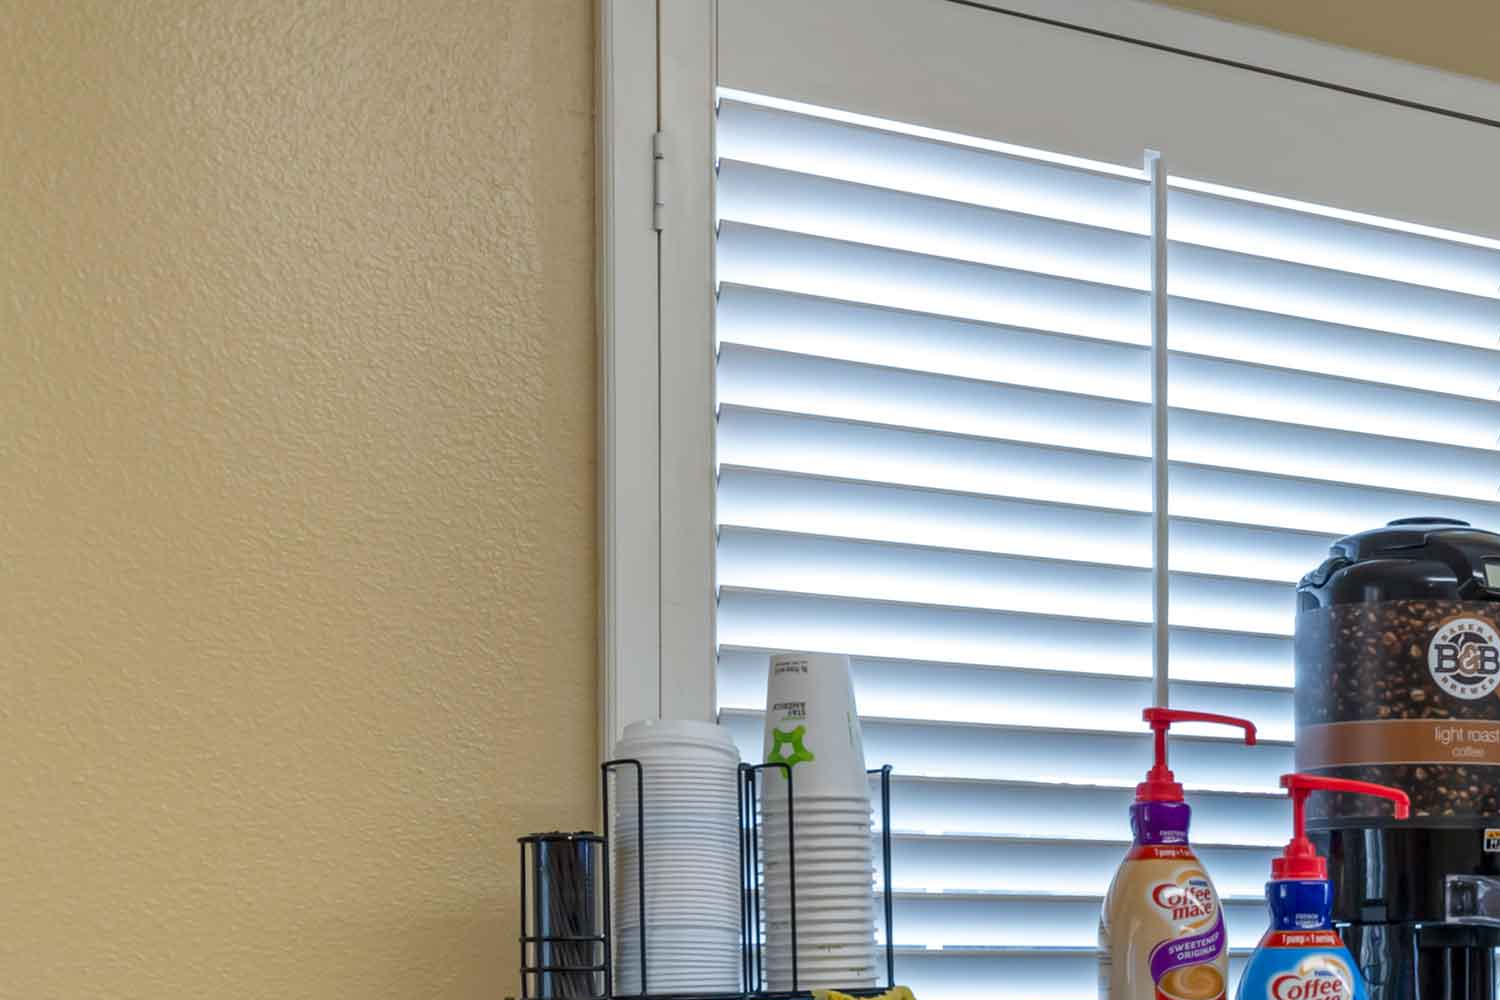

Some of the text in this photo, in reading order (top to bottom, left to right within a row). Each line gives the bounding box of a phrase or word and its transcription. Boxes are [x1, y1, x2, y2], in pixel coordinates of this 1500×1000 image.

[1434, 642, 1500, 675] B&B
[1434, 727, 1500, 745] light roast
[1152, 883, 1211, 910] Coffee
[1173, 901, 1212, 920] mate
[1177, 944, 1217, 961] ORIGINAL
